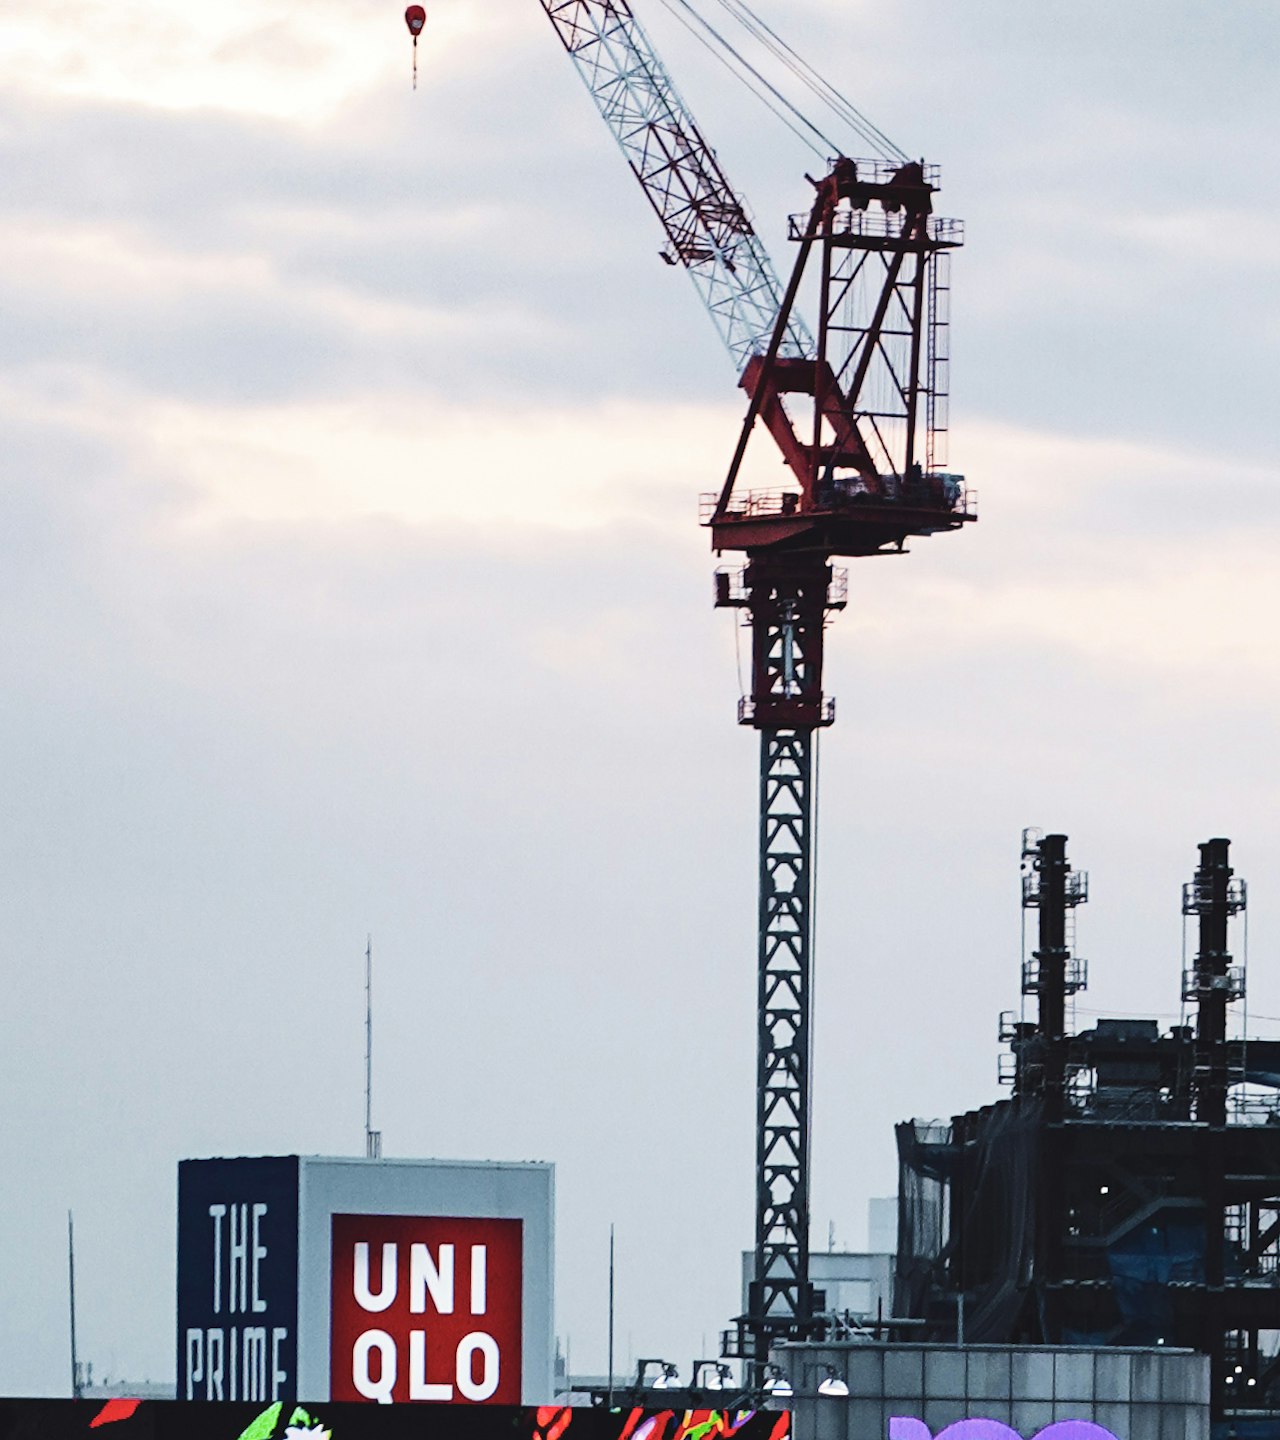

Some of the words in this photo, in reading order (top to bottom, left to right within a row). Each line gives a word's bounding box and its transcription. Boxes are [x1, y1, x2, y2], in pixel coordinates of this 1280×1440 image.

[210, 1203, 269, 1316] THE
[352, 1241, 488, 1316] UNI
[186, 1326, 288, 1402] PRIME
[351, 1330, 502, 1403] QLO
